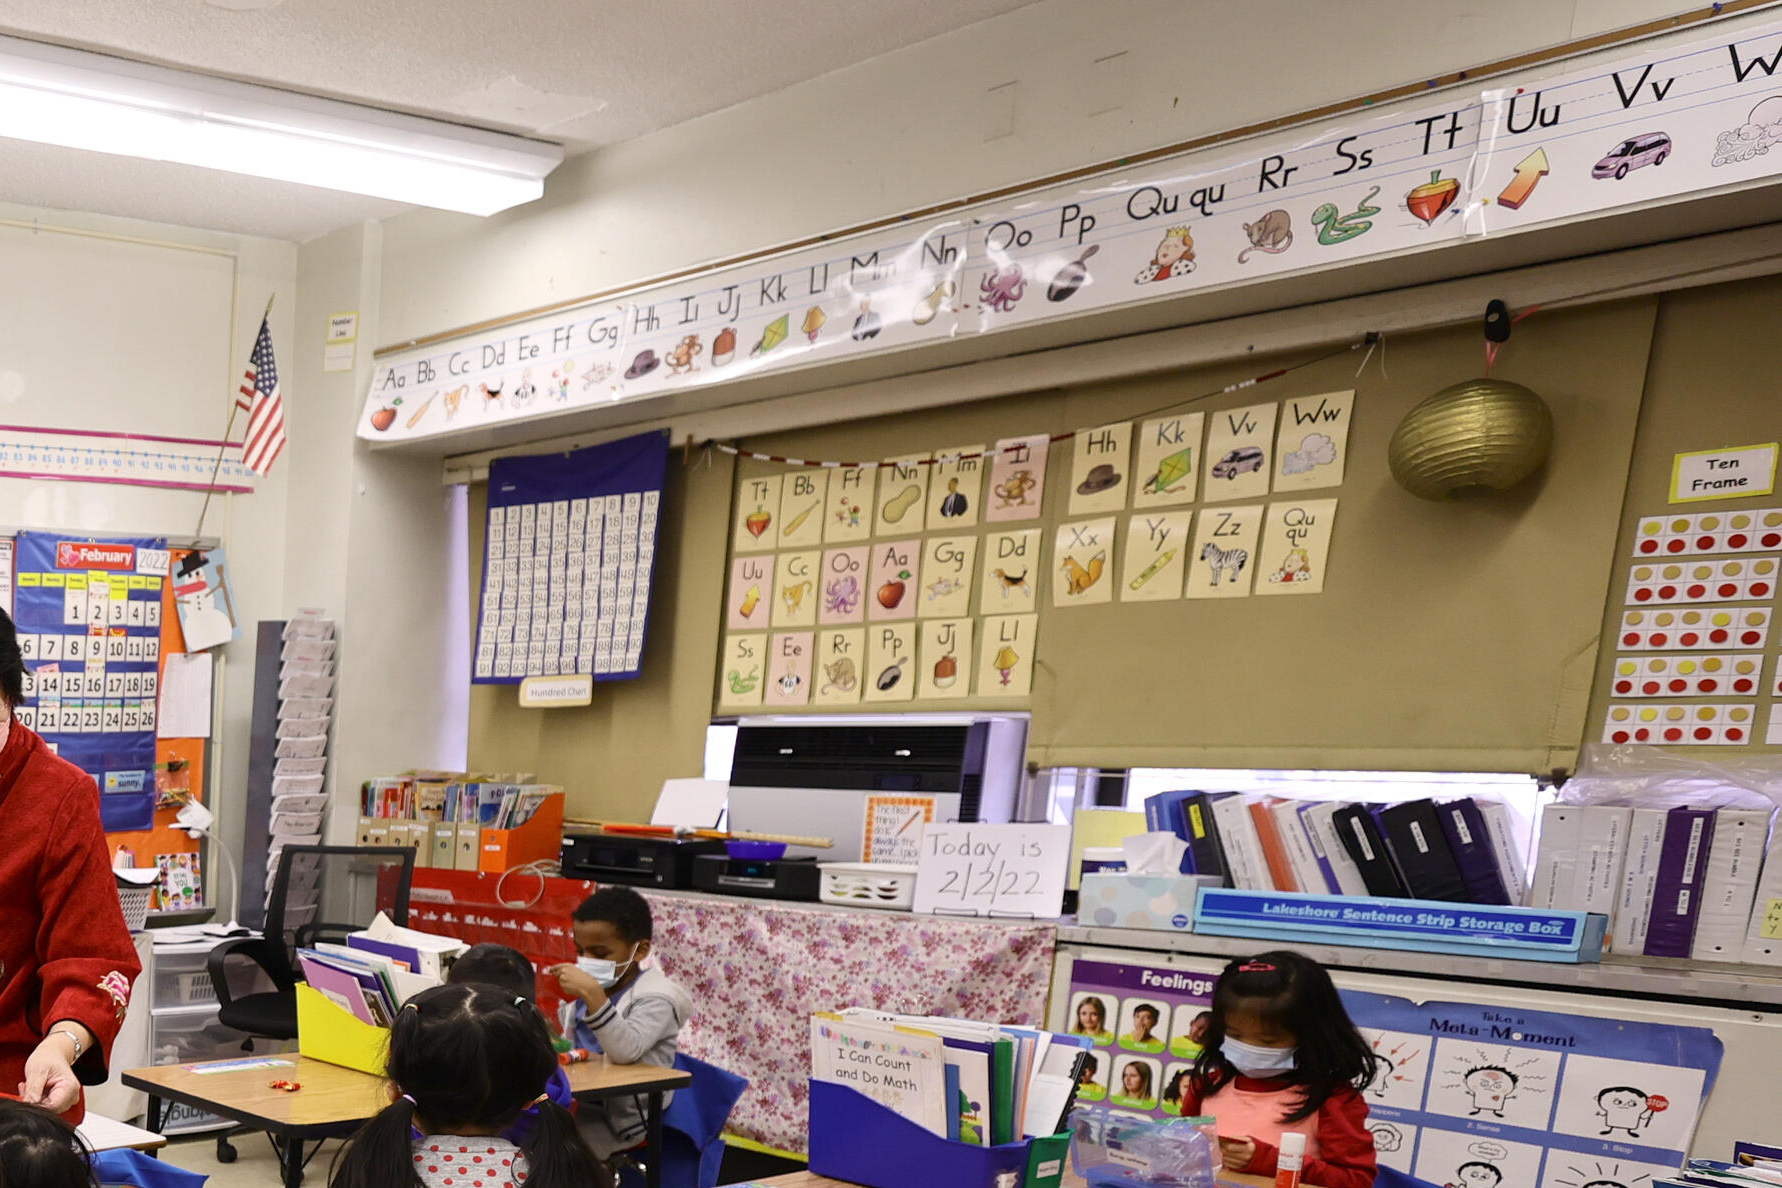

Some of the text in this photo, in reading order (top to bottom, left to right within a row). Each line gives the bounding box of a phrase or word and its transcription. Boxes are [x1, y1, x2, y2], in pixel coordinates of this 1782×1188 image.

[383, 63, 1674, 391] Aa Bb Cc Dd Ee Gg Hh Jj Kk Pp Qu qu Rr Ss Tt Uu Vv
[1087, 399, 1341, 454] Hh Kk Vv Ww
[1706, 459, 1739, 470] Ten
[752, 469, 864, 500] Tt Bb Ff
[1692, 478, 1747, 491] Frame
[1146, 513, 1241, 550] Yy Zz
[80, 548, 132, 565] February
[139, 551, 168, 569] 2022
[788, 536, 1026, 576] Cc Oo Aa Gg Dd
[73, 605, 156, 620] 1 2 3 4 5
[48, 641, 156, 657] 7 8 10 12
[782, 629, 902, 657] Ee Pp
[43, 678, 139, 692] 14 15 16 18
[531, 686, 587, 697] Hundred Chart
[41, 712, 153, 727] 21 23 25 26
[926, 832, 1001, 873] Today
[1021, 835, 1042, 857] is
[938, 860, 1044, 904] 2/2/22
[1263, 902, 1562, 935] Lakeshore Sentence Strip Storage Box
[1141, 970, 1214, 996] Feelings
[1482, 1011, 1513, 1024] Take
[838, 1048, 911, 1072] I Can Count
[835, 1068, 918, 1091] and Do Math
[1646, 1097, 1668, 1109] STOP
